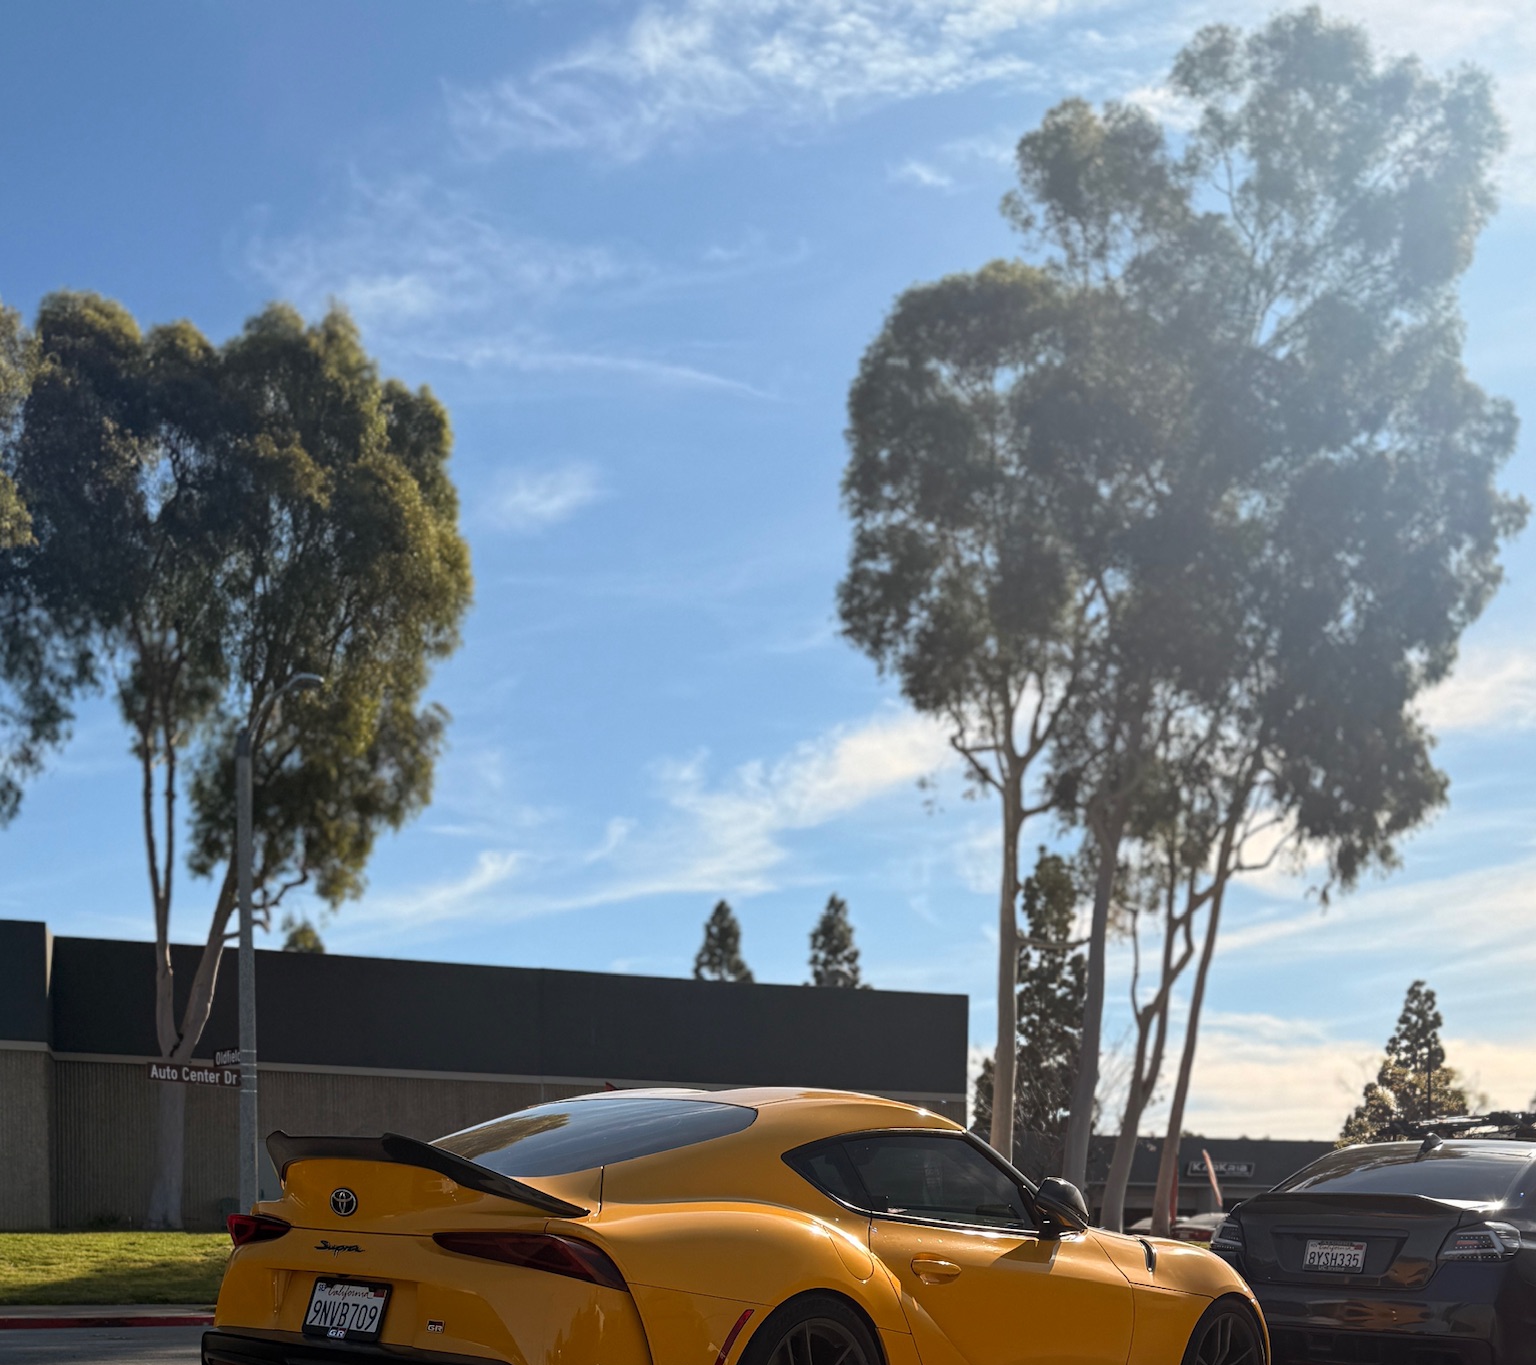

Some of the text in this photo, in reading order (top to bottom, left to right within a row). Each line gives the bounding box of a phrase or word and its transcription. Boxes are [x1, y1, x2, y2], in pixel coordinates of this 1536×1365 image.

[150, 1064, 237, 1085] Auto Center Dr
[314, 1240, 365, 1258] Supra
[1308, 1251, 1360, 1268] 8YSH335
[328, 1284, 373, 1300] California
[308, 1299, 378, 1331] 9NVB709
[328, 1328, 345, 1338] GR
[427, 1324, 443, 1332] GR
